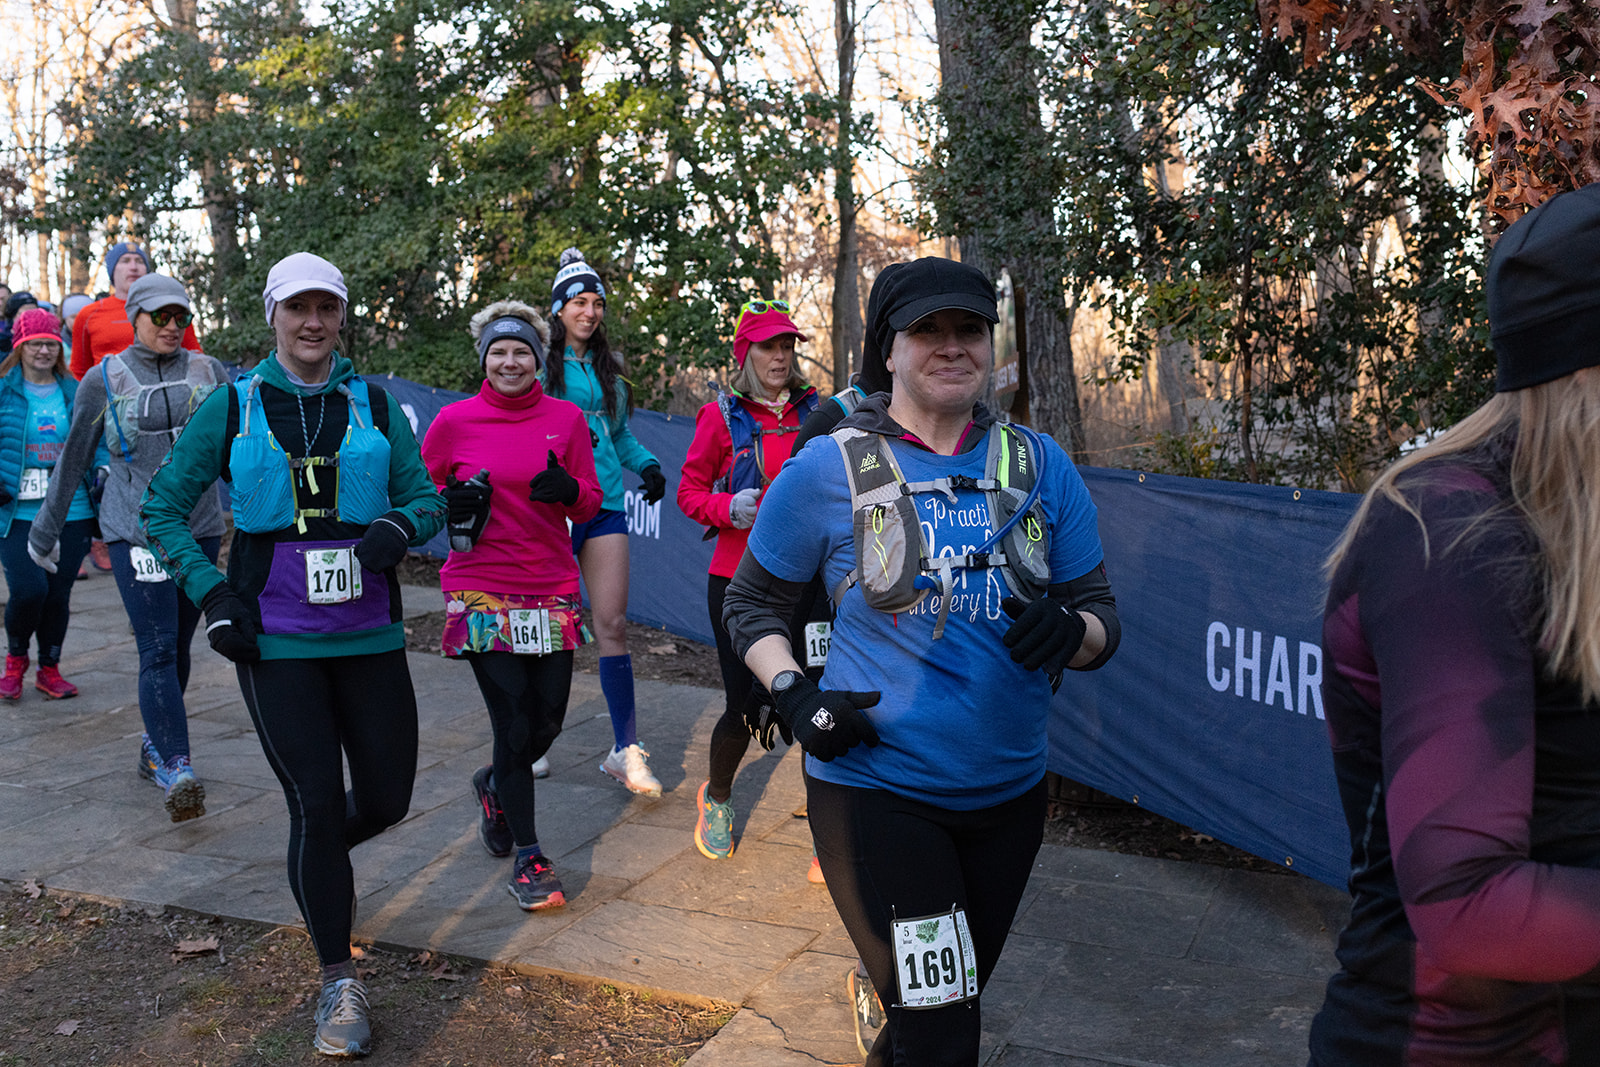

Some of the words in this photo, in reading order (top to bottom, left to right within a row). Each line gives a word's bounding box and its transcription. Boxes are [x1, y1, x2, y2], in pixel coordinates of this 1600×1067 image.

[624, 490, 662, 540] COM
[313, 568, 347, 593] 170
[930, 593, 981, 623] eery
[514, 625, 539, 645] 164
[1206, 621, 1326, 720] CHAR
[903, 926, 910, 937] 5
[905, 947, 957, 990] 169
[925, 996, 942, 1004] 2024
